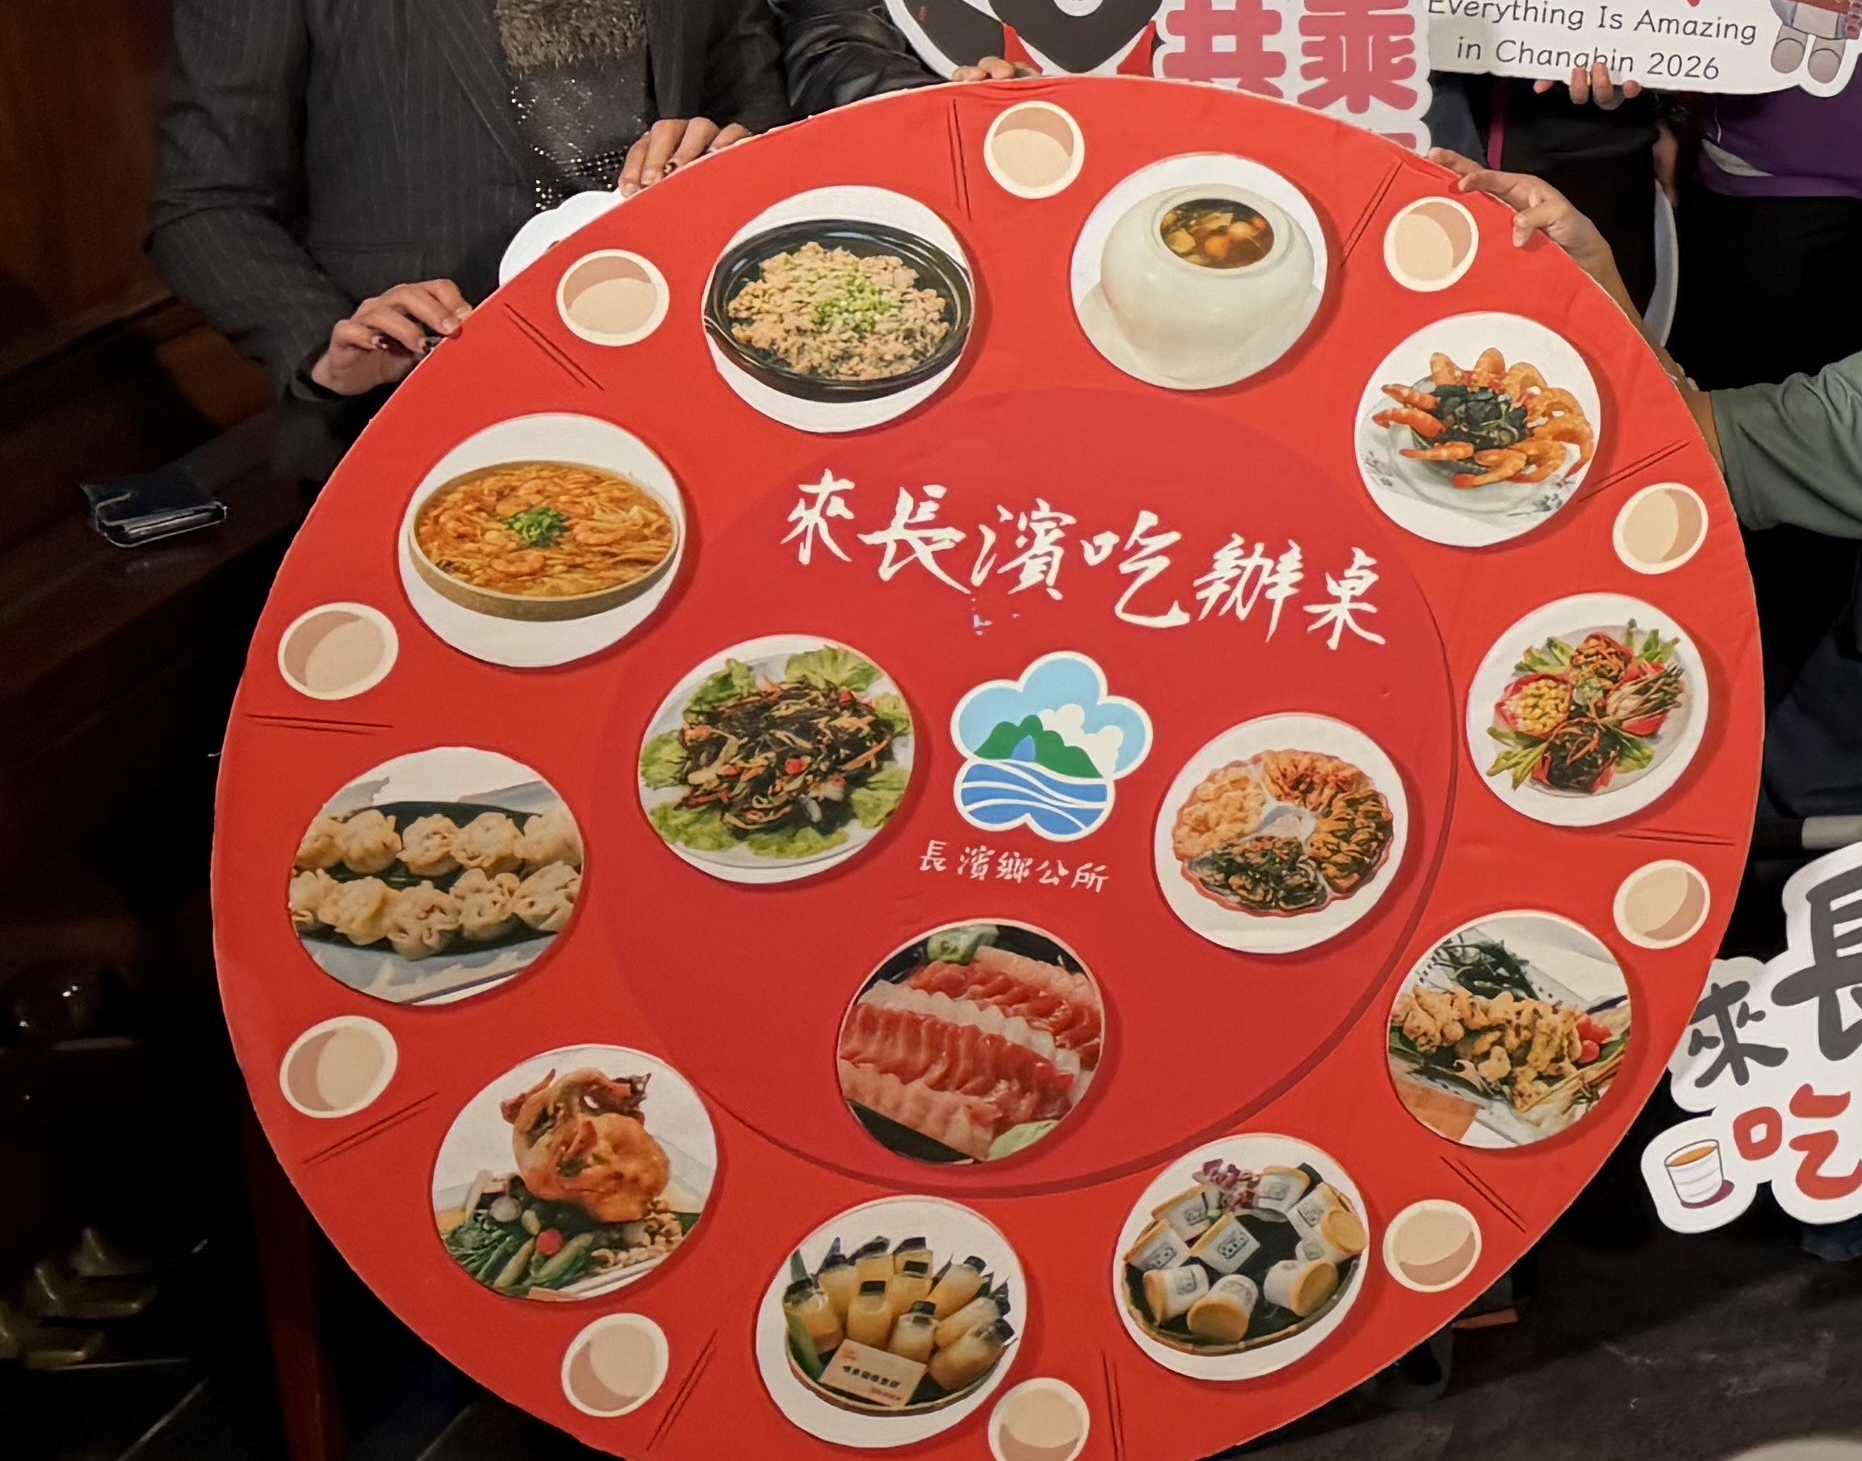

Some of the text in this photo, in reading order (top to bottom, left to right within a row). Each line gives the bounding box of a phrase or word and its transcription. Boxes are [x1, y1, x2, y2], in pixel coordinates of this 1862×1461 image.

[1598, 5, 1624, 31] Is
[1634, 9, 1757, 45] Amazing
[1457, 36, 1482, 61] in
[1647, 51, 1720, 80] 2026
[917, 838, 1110, 894] 長濱鄉公所
